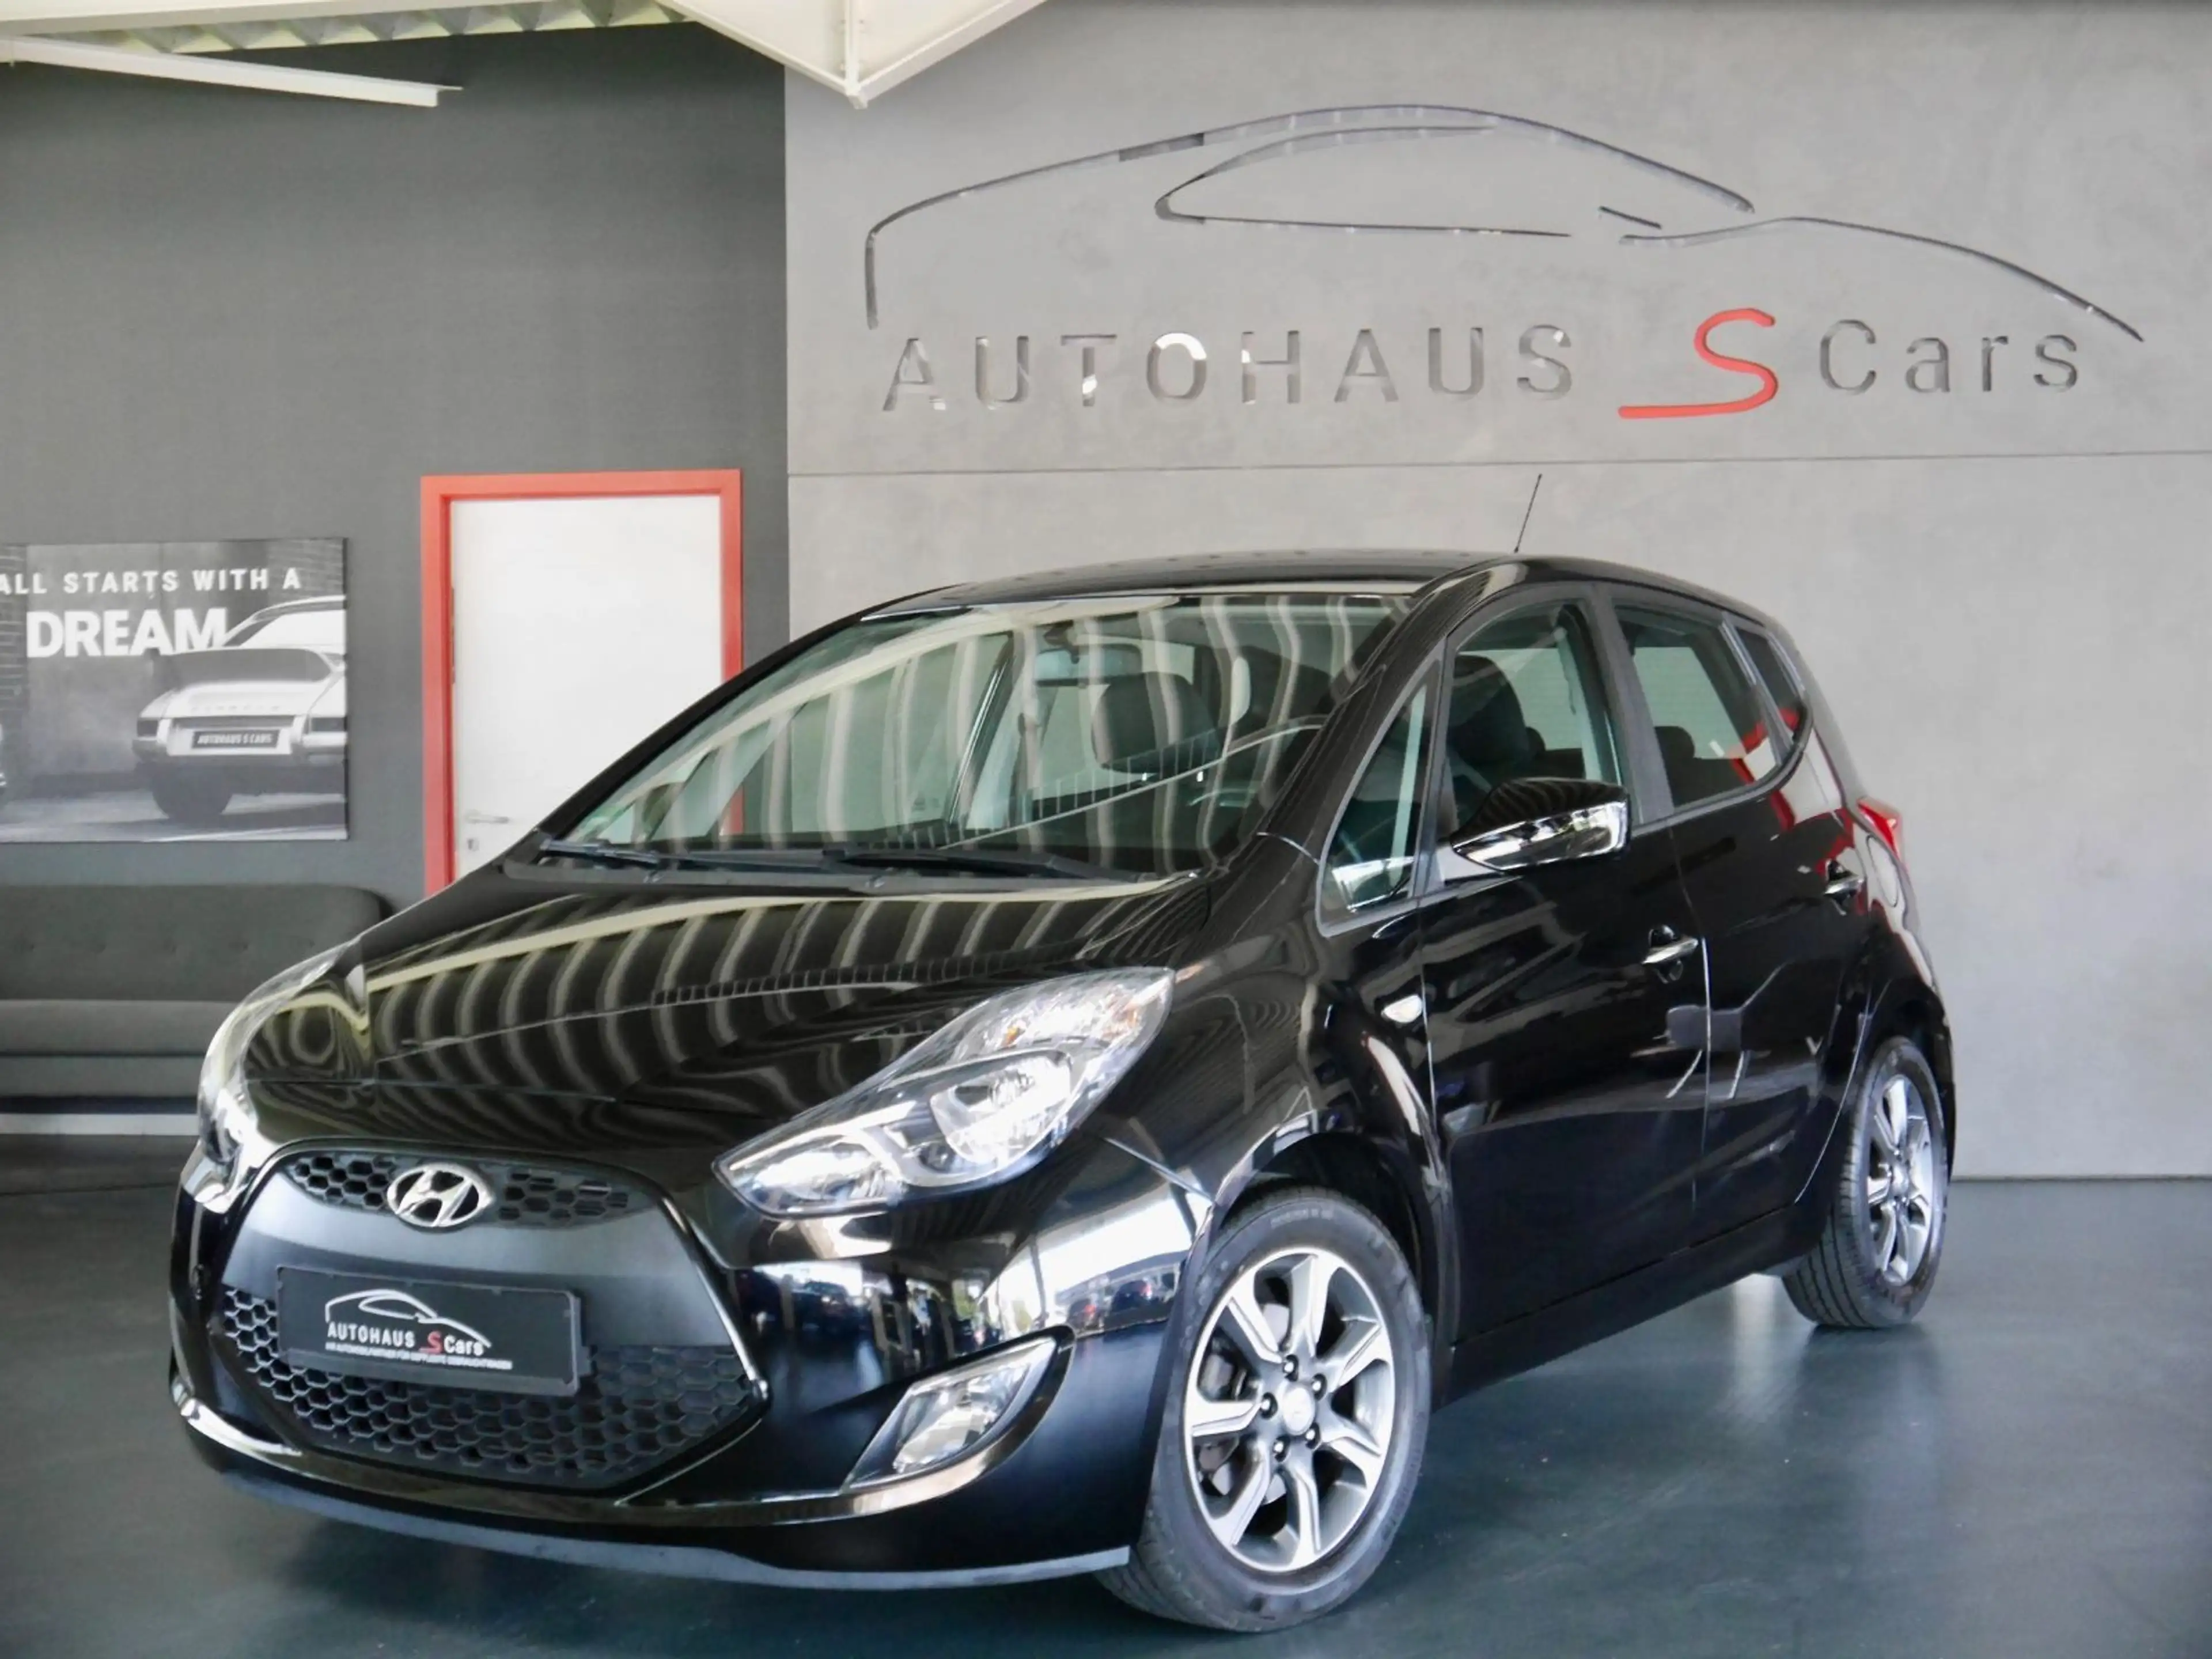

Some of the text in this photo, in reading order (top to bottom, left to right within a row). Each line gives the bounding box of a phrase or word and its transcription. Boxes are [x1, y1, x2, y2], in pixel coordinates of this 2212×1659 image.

[882, 308, 2078, 419] AUTOHAUS S Cars
[63, 569, 180, 594] STARTS
[192, 567, 269, 592] WITH
[282, 567, 301, 589] A
[26, 607, 228, 658] DREAM
[327, 1321, 415, 1349] AUTOHAUS
[419, 1331, 443, 1355] S
[443, 1334, 484, 1357] Cars
